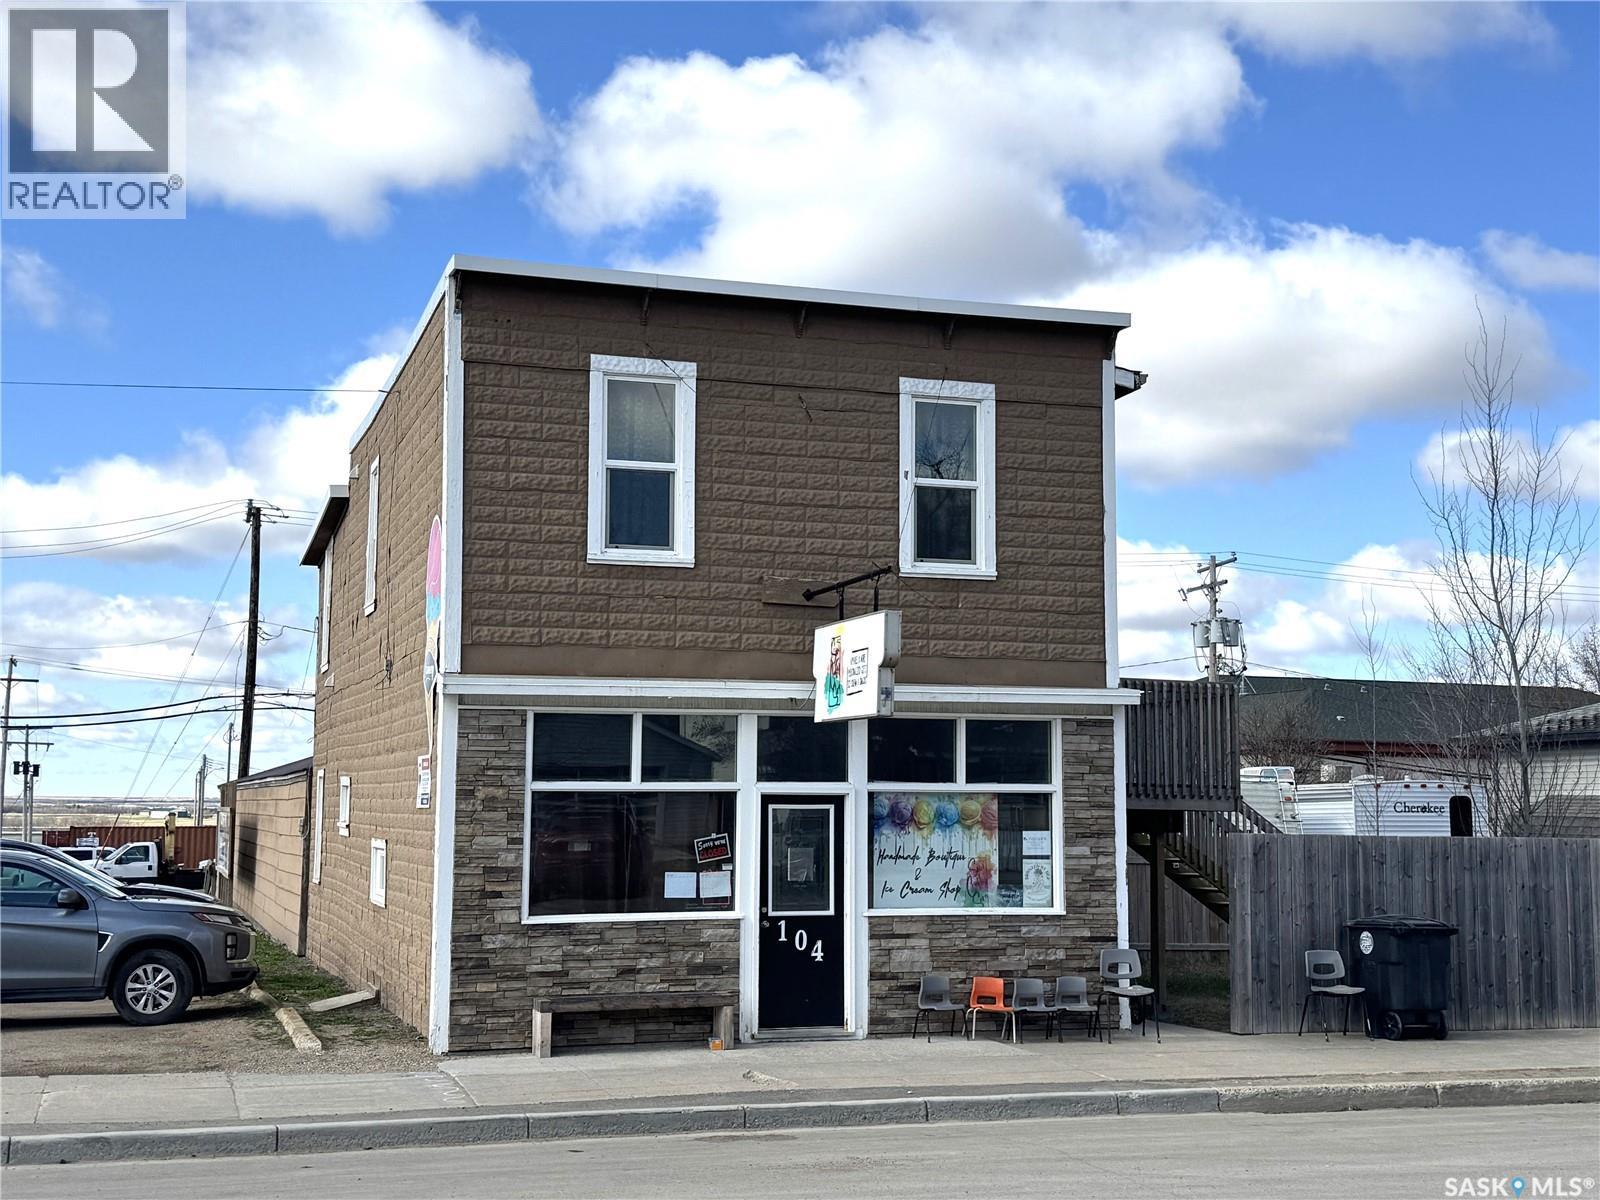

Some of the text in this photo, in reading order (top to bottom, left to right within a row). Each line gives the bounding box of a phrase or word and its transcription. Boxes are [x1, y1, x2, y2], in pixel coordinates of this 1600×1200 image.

[1393, 801, 1446, 814] Cherokee
[701, 848, 727, 859] CLOSED
[876, 845, 966, 869] Handmade Boutique
[881, 877, 961, 901] Ice Cream Shop
[778, 919, 824, 962] 104
